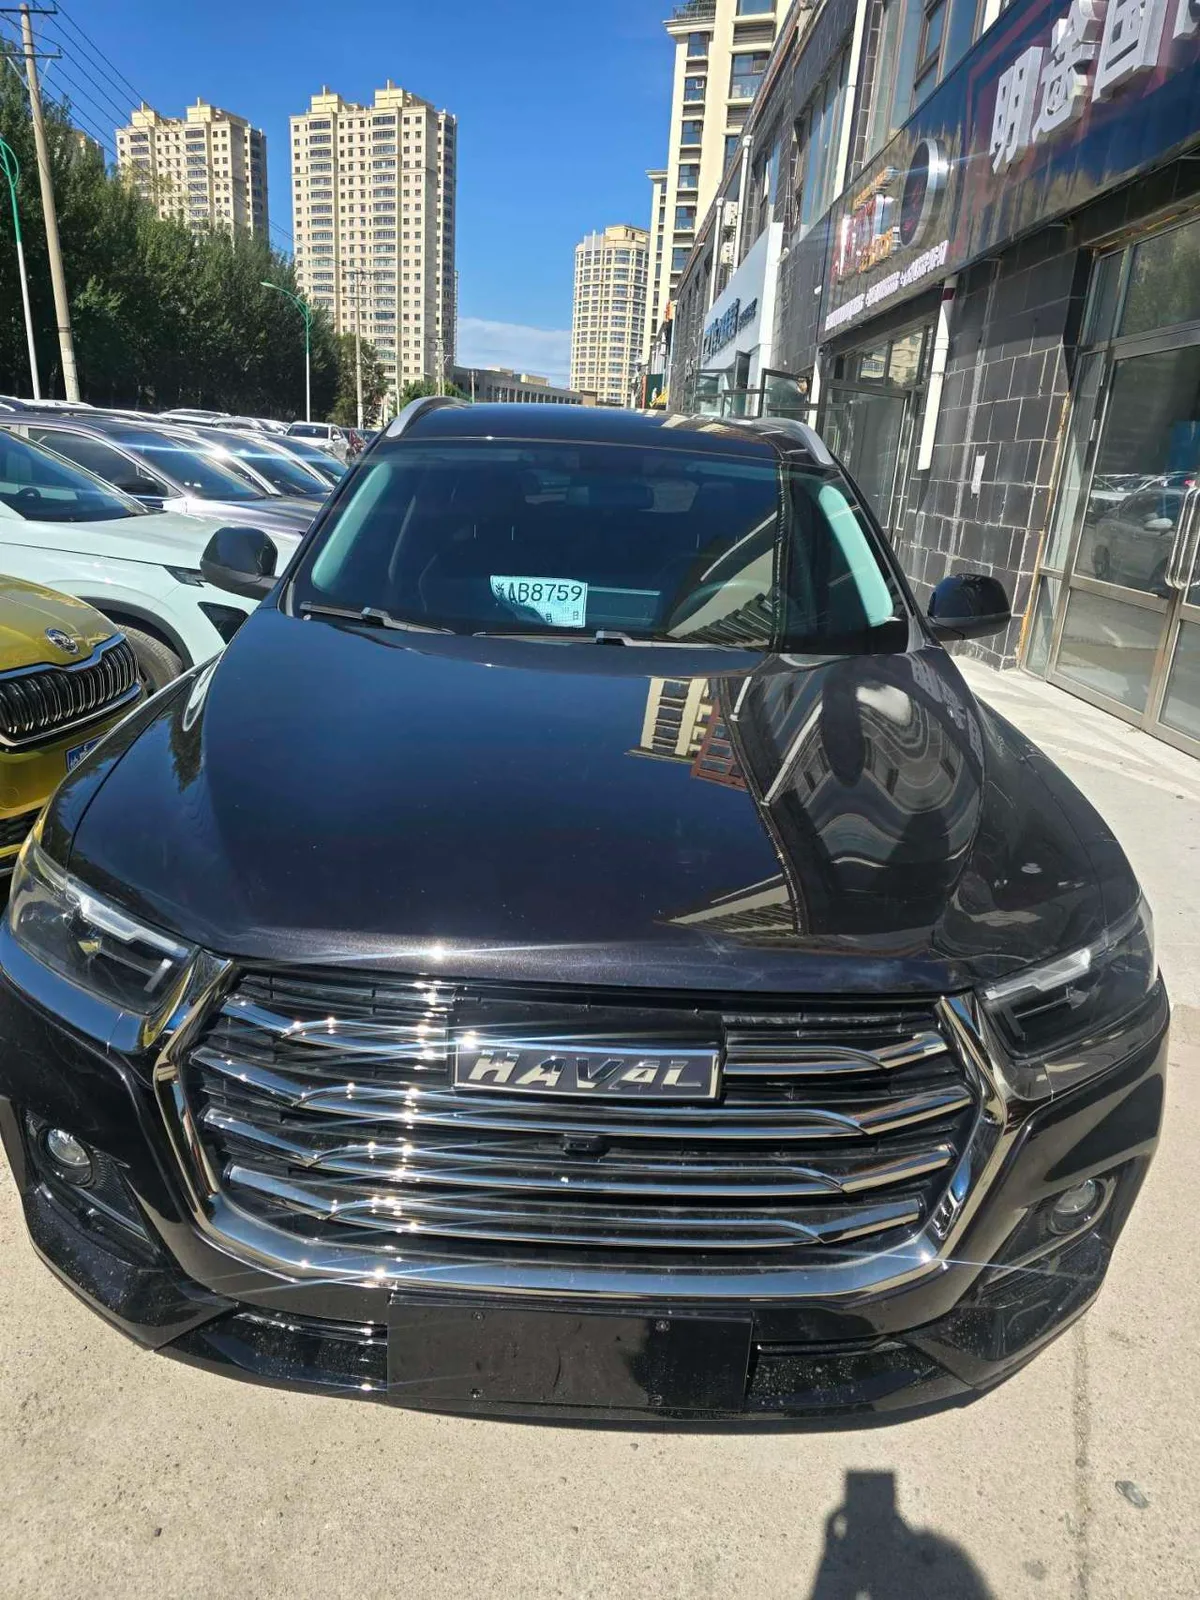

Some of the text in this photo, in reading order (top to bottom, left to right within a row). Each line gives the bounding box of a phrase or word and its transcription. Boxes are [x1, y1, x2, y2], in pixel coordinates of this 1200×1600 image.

[989, 0, 1200, 173] 明途国
[467, 1050, 701, 1091] HAVAL
